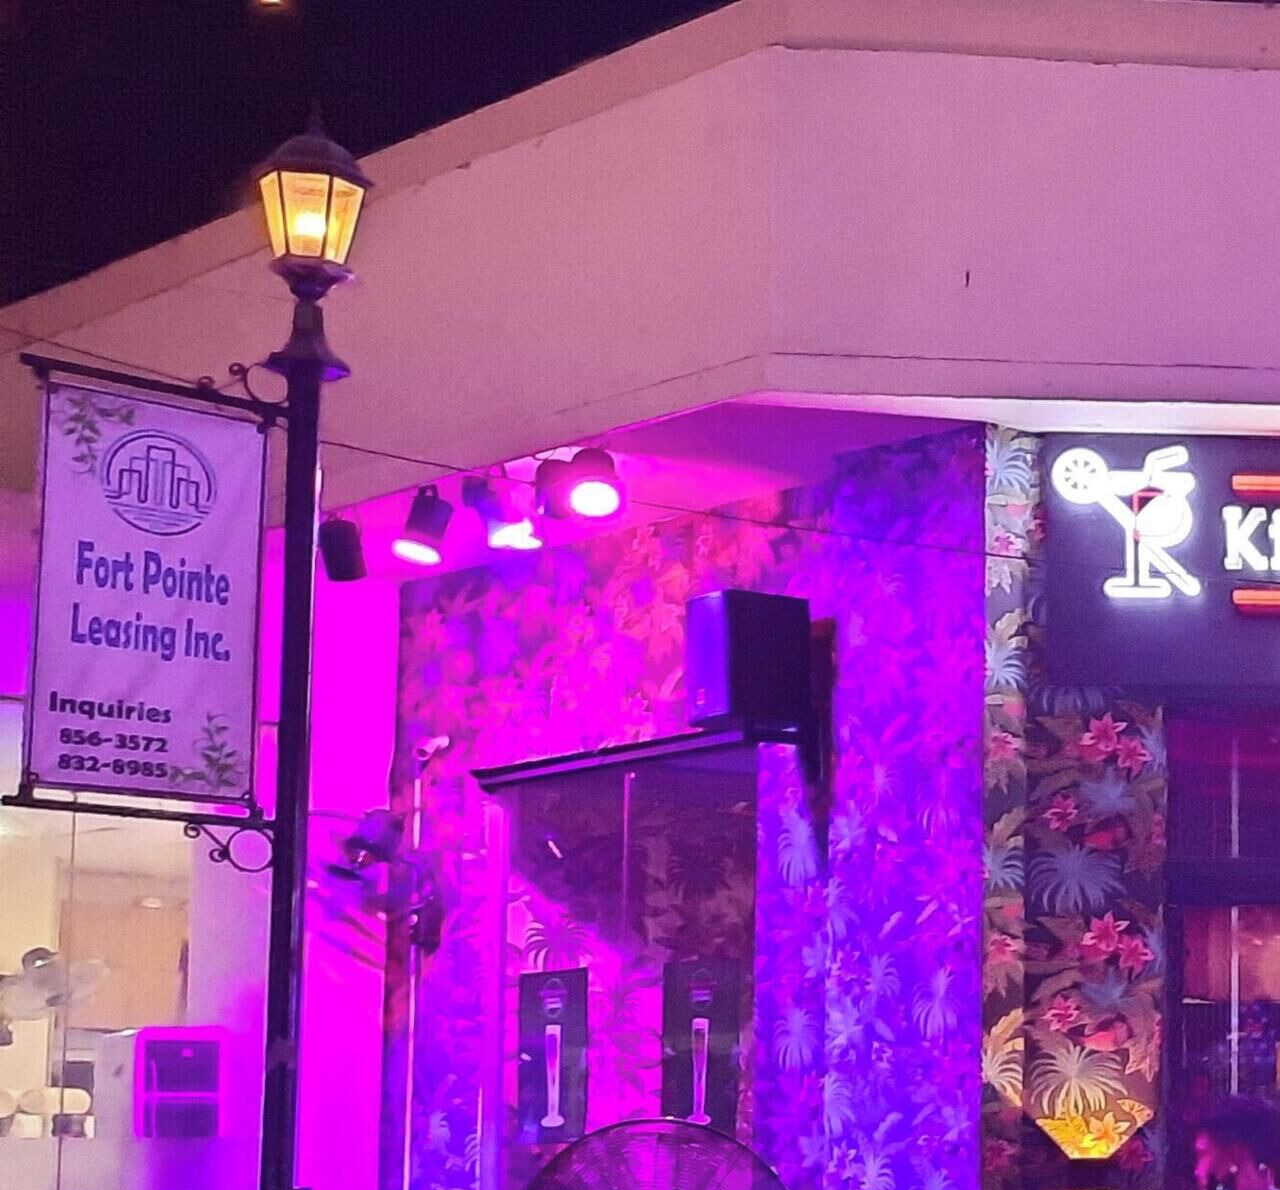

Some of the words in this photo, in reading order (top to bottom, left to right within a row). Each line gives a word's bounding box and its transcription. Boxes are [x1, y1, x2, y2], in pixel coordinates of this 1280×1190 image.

[76, 540, 134, 592] Fort
[143, 551, 230, 606] Pointe
[71, 603, 176, 661] Leasing
[184, 618, 231, 662] Inc.
[49, 690, 173, 724] Inquiries
[59, 727, 169, 753] 856-3572
[57, 753, 169, 779] 832-8985
